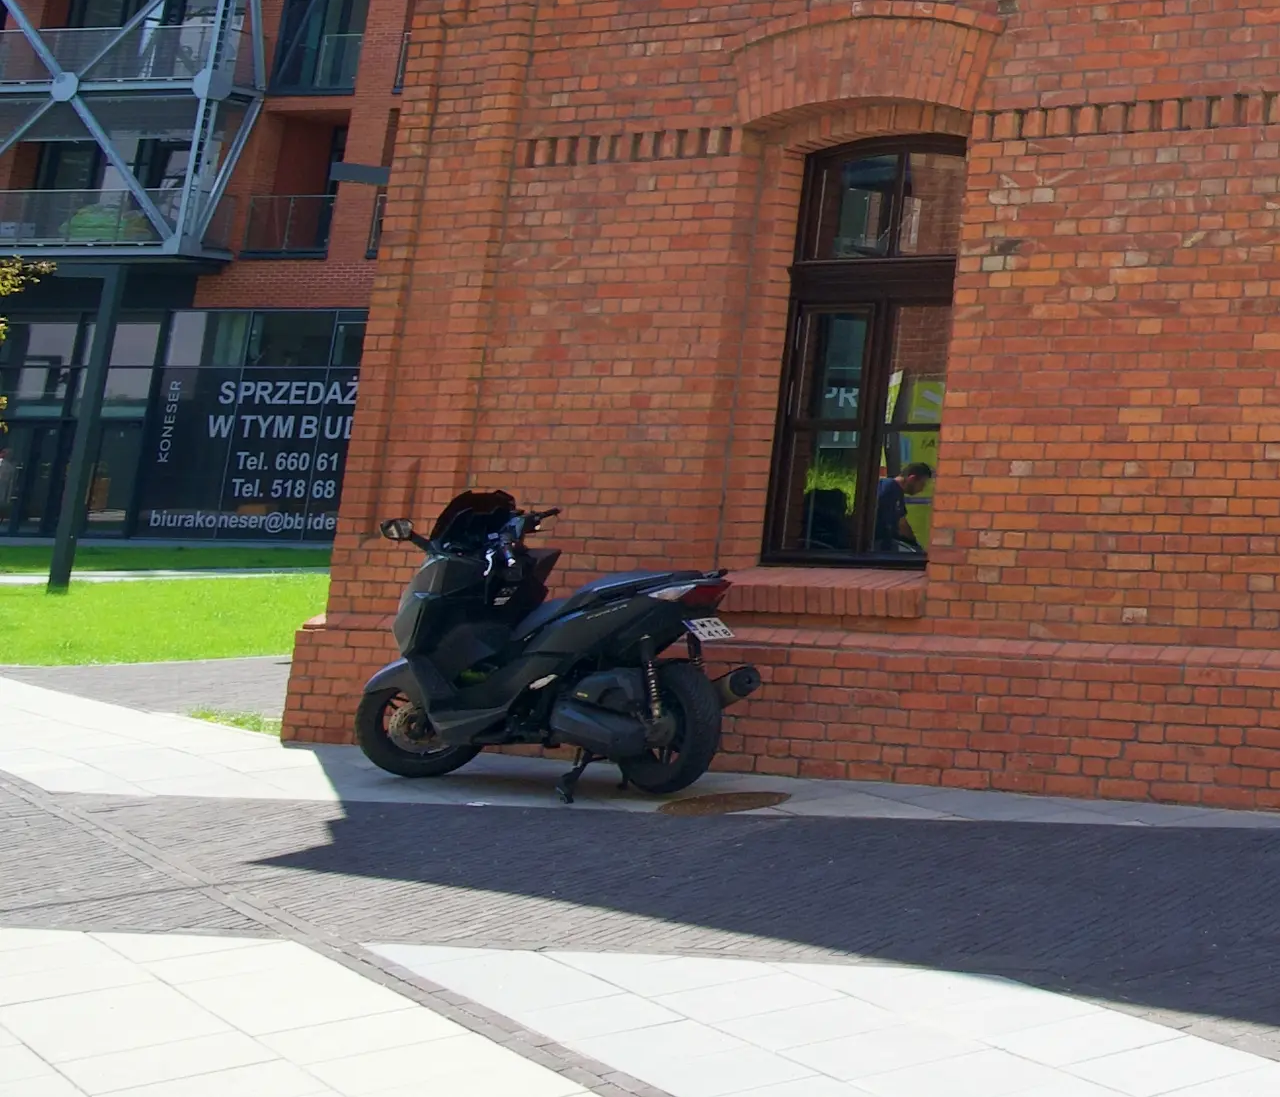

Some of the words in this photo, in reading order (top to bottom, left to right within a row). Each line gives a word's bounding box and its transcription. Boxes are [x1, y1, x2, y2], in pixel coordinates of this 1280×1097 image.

[218, 375, 360, 405] SPRZEDAŻ
[157, 380, 182, 463] KONESER
[208, 414, 235, 439] W
[241, 414, 296, 439] TYM
[236, 451, 269, 471] Tel.
[275, 452, 310, 472] 660
[316, 452, 339, 472] 61
[232, 478, 264, 498] Tel.
[271, 478, 306, 499] 518
[312, 479, 336, 499] 68
[150, 510, 338, 533] biurakoneser@bbide
